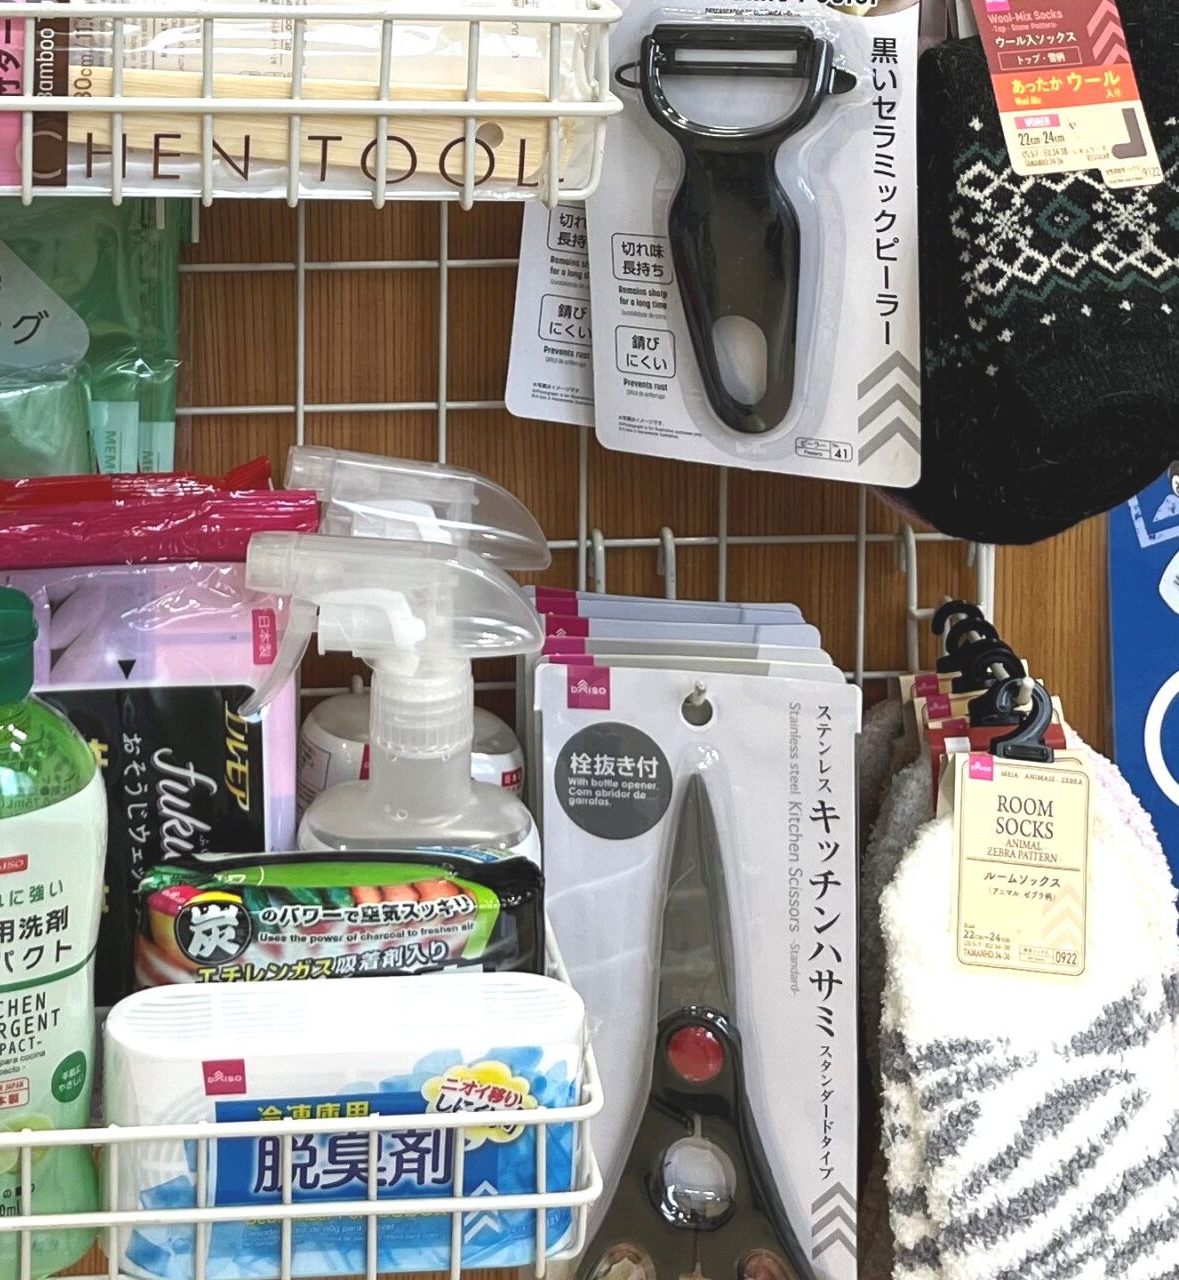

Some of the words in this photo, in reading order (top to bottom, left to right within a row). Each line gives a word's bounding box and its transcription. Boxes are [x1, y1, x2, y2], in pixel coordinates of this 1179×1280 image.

[987, 11, 1032, 25] Wool-Mix
[1033, 9, 1063, 20] Socks
[995, 32, 1077, 48] ウール入ソックス
[1011, 77, 1063, 94] あったか
[1067, 70, 1121, 91] ウール
[871, 37, 900, 346] 黒いセラミックピーラー
[621, 241, 665, 259] 切れ味
[622, 261, 664, 278] 長持ち
[558, 304, 588, 320] 錆び
[652, 300, 668, 310] time
[549, 321, 591, 339] にくい
[631, 334, 660, 350] 錆び
[625, 353, 668, 371] にくい
[623, 378, 653, 391] Prevents
[834, 447, 850, 461] 41
[571, 679, 606, 695] DAISO
[790, 702, 800, 764] Stainless
[816, 703, 833, 793] ステンレス
[570, 752, 660, 779] 栓抜き付
[568, 777, 589, 786] With
[591, 778, 620, 788] bottle
[791, 766, 800, 797] steel
[568, 787, 592, 796] Com
[595, 789, 631, 800] abridor
[997, 795, 1054, 818] ROOM
[995, 817, 1054, 839] SOCKS
[1005, 839, 1043, 851] ANIMAL
[986, 847, 1016, 859] ZEBRA
[1018, 850, 1058, 863] PATTERN
[983, 872, 1061, 888] ルームソックス
[788, 867, 803, 934] Scissors
[808, 797, 843, 1040] キッチンハサミ
[187, 905, 250, 960] 炭
[258, 933, 288, 943] Uses
[309, 933, 343, 945] power
[360, 929, 404, 941] charcoal
[420, 924, 460, 936] freshen
[1055, 951, 1077, 965] 0922
[0, 1057, 18, 1067] para
[20, 1050, 46, 1060] cocina
[819, 1044, 837, 1181] スタンダードタイプ
[253, 1128, 454, 1194] 脱臭剤
